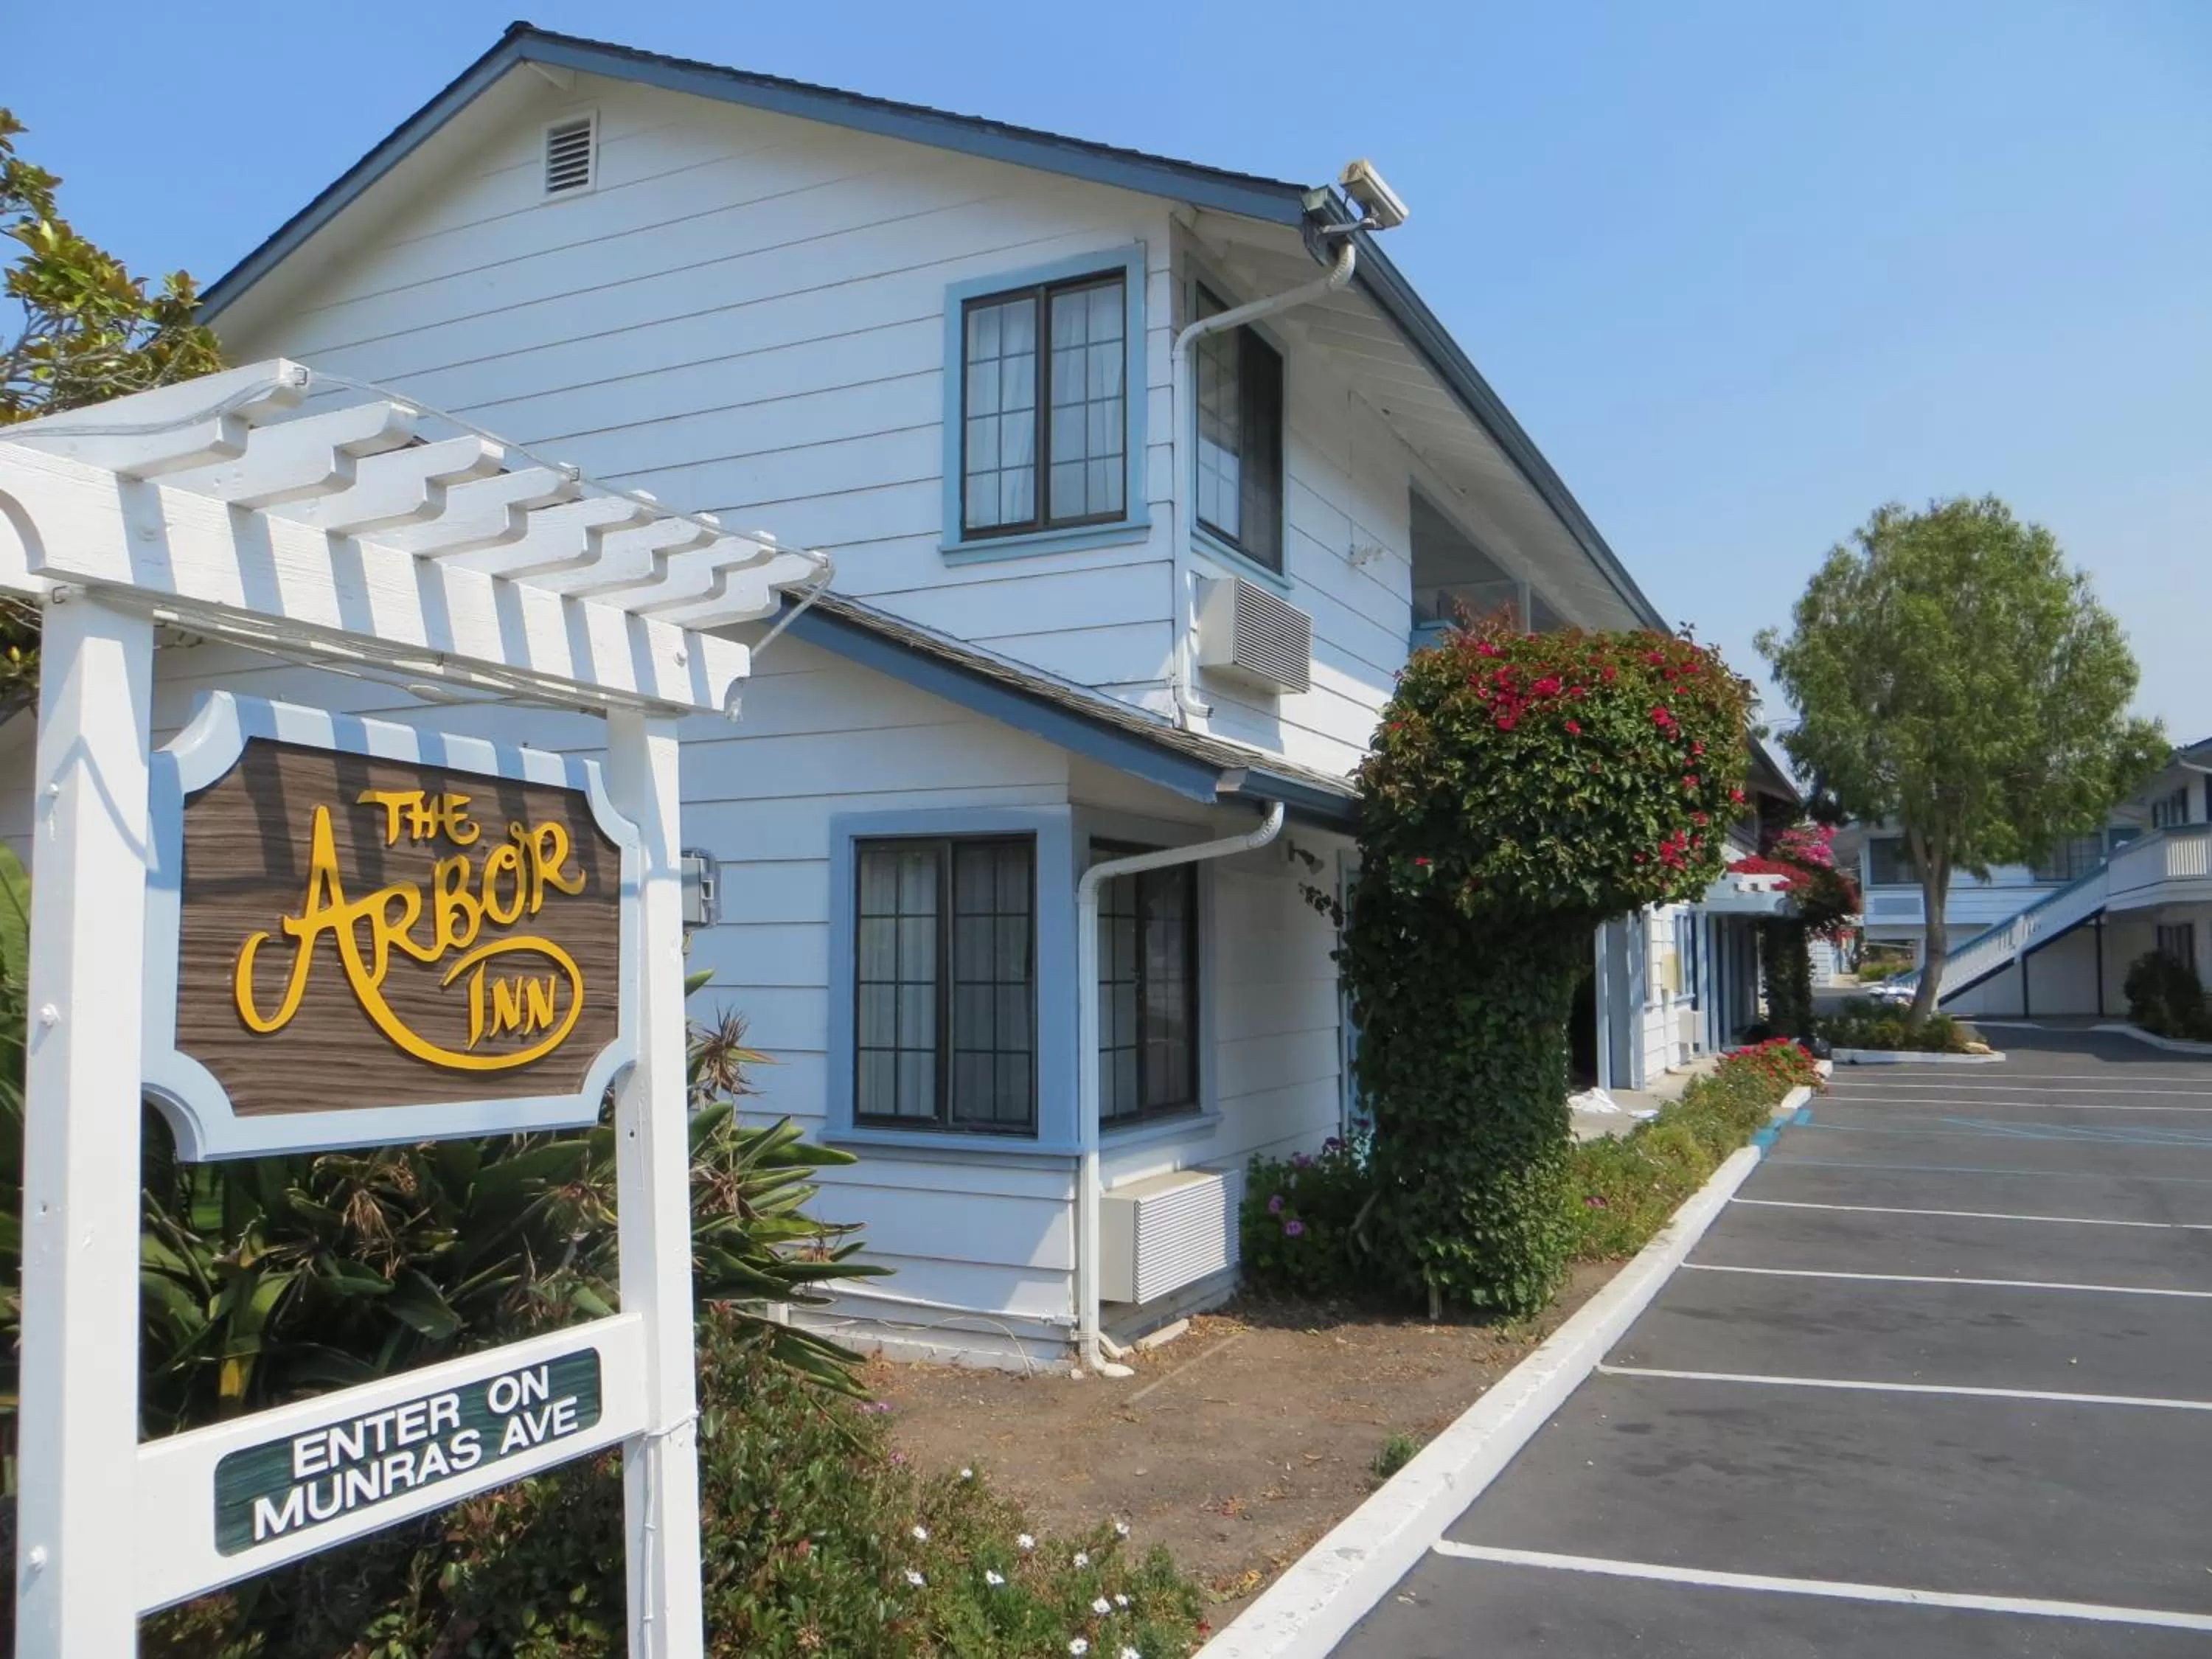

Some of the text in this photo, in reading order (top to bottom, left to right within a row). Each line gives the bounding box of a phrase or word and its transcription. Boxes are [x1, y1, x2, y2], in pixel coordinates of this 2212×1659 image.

[358, 789, 481, 846] THE
[232, 804, 586, 1070] ARBOR
[465, 960, 557, 1051] INN
[254, 1395, 580, 1541] MUNRAS AVE
[293, 1364, 550, 1479] ENTER ON
